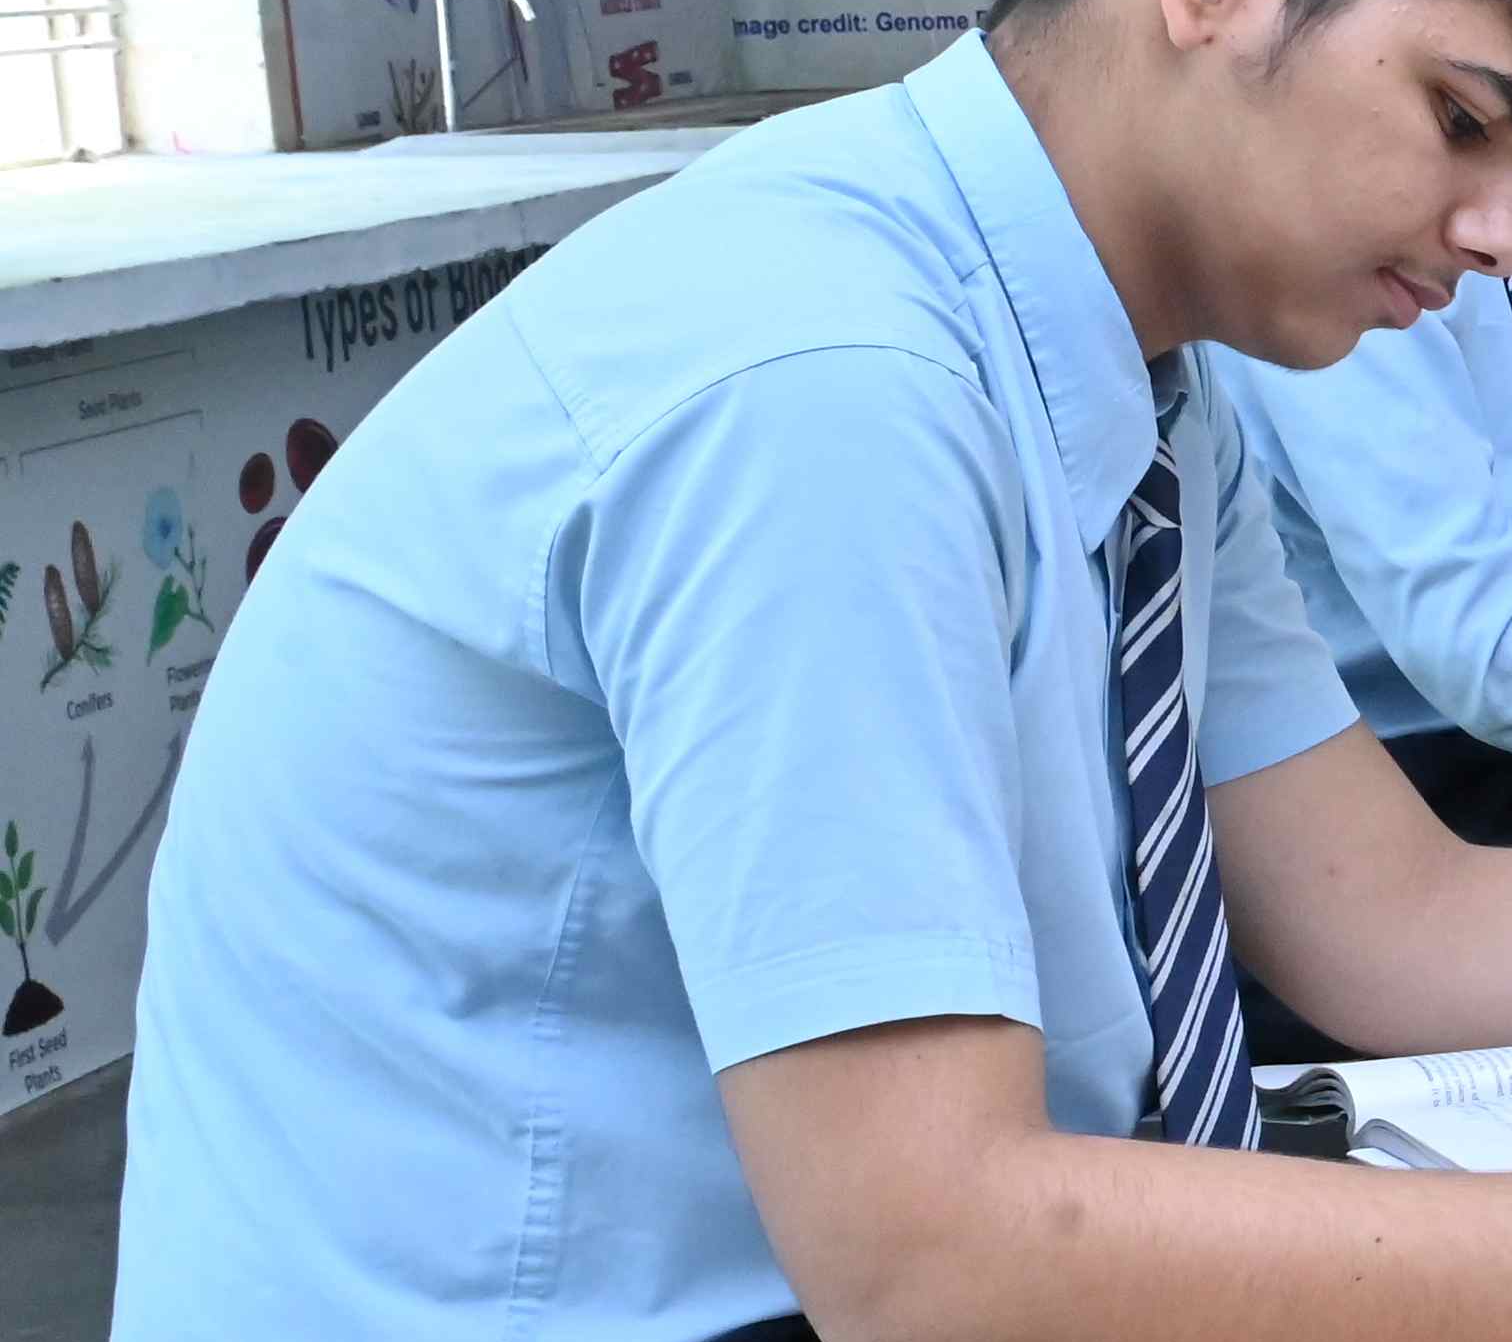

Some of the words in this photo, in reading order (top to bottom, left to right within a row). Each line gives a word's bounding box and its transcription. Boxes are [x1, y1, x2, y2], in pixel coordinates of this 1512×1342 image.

[797, 10, 868, 35] credit:
[876, 9, 969, 33] Genome
[39, 1027, 67, 1059] Seed
